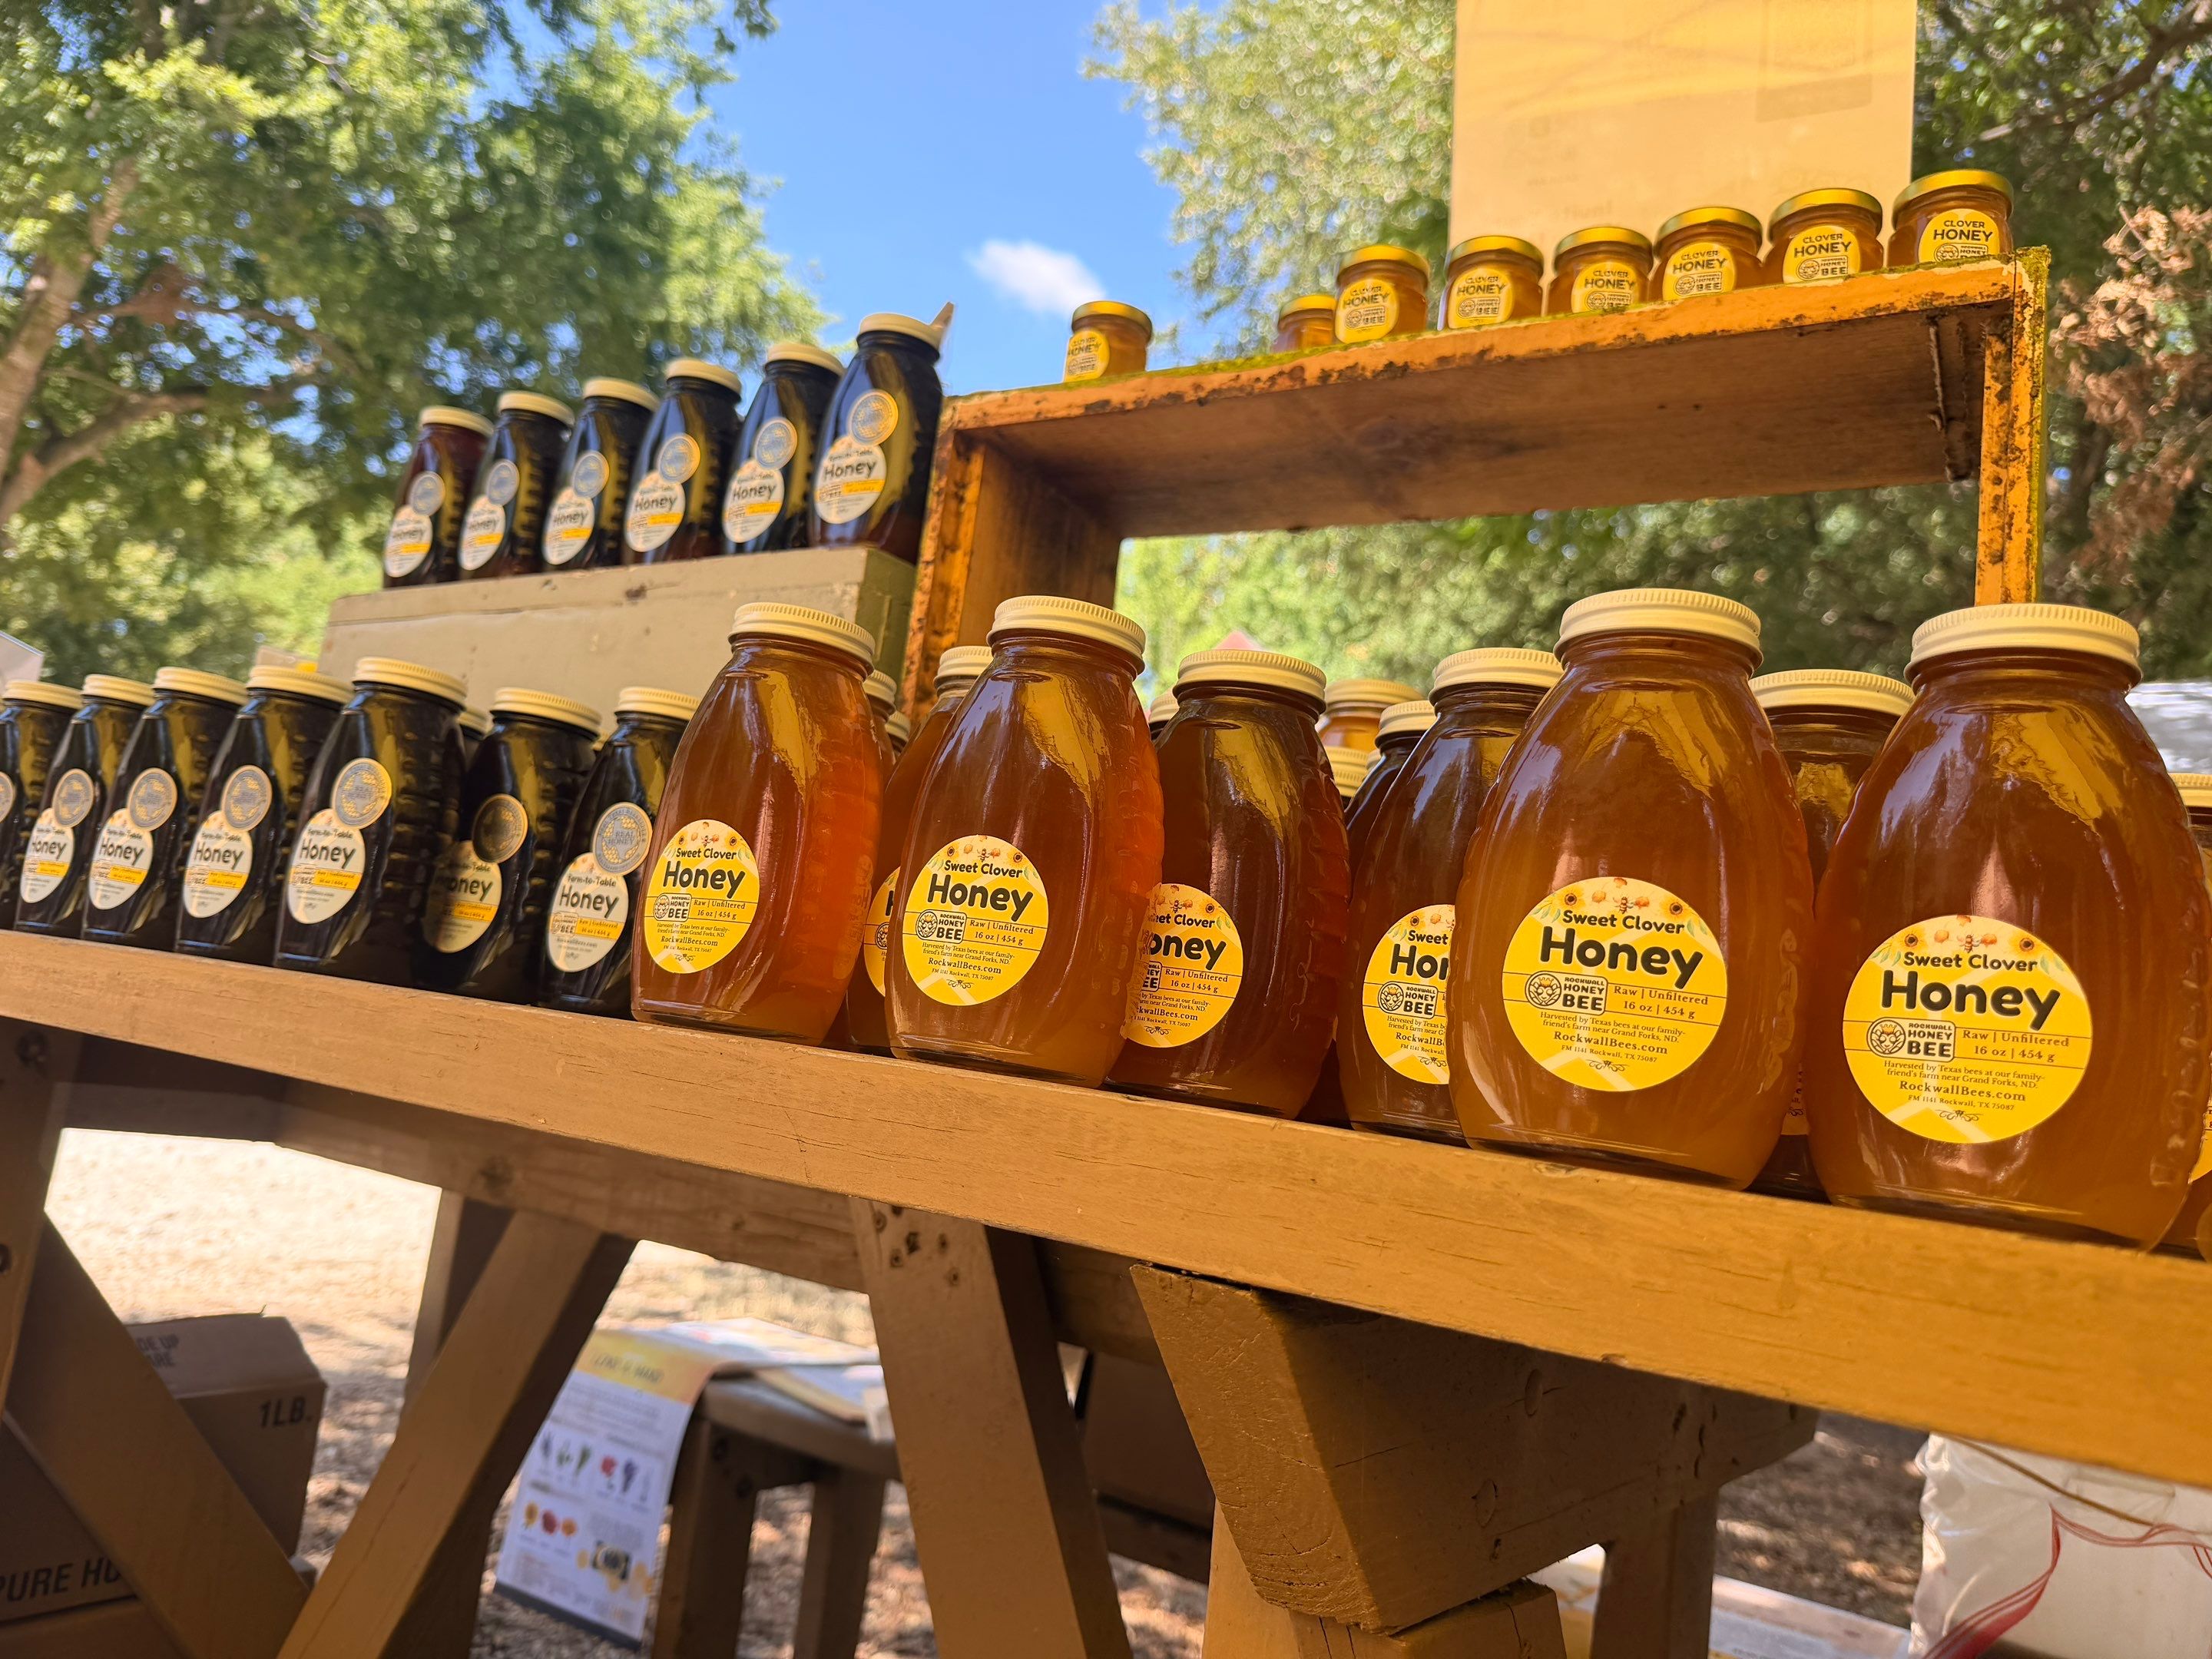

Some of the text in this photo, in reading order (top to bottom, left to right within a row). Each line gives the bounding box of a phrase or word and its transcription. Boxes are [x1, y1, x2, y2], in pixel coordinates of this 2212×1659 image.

[1803, 233, 1843, 243] CLOVER
[1934, 229, 1992, 242] HONEY
[1681, 251, 1718, 260] CLOVER
[1794, 242, 1851, 258] HONEY
[1673, 258, 1727, 273] HONEY
[1821, 267, 1846, 276] BEE
[1457, 284, 1505, 296] HONEY
[1584, 279, 1634, 290] HONEY
[1697, 283, 1721, 291] BEE
[1343, 293, 1390, 310] HONEY
[824, 461, 876, 479] Honey
[733, 485, 776, 500] Honey
[635, 496, 677, 512] Honey
[554, 513, 588, 528] Honey
[31, 837, 67, 859] Honey
[99, 838, 144, 866] Honey
[194, 842, 243, 870] Honey
[300, 839, 356, 869] Honey
[676, 848, 737, 859] Sweet Clover
[944, 859, 1023, 878] Sweet Clover
[663, 860, 746, 899] Honey
[446, 878, 493, 902] oney
[927, 873, 1033, 922] Honey
[559, 884, 619, 919] Honey
[712, 901, 746, 909] Unfiltered
[668, 909, 688, 919] BEE
[1174, 914, 1215, 928] Clover
[1562, 909, 1685, 934] Sweet Clover
[936, 927, 962, 940] BEE
[993, 922, 1034, 934] Unfiltered
[661, 936, 718, 946] RockwallBees.com
[1408, 930, 1448, 945] Sweet
[1151, 933, 1227, 970] oney
[1539, 926, 1704, 989] Honey
[929, 958, 1002, 974] RockwallBees.com
[1903, 951, 2038, 972] Sweet Clover
[1143, 977, 1158, 988] EE
[1188, 972, 1228, 982] Unfiltered
[1565, 977, 1604, 985] ROCKWALL
[1406, 992, 1435, 1002] HONEY
[1564, 984, 1604, 995] HONEY
[1614, 986, 1708, 1005] Raw Unfiltered
[1403, 1001, 1434, 1015] BEE
[1562, 994, 1604, 1011] BEE
[1881, 970, 2061, 1031] Honey
[1137, 1006, 1198, 1021] kwallBees.com
[1624, 1001, 1635, 1009] 16
[1664, 1006, 1684, 1015] 454
[1688, 1011, 1695, 1019] g
[1387, 1015, 1413, 1024] Harvested
[1541, 1012, 1577, 1022] Harvested
[1579, 1016, 1588, 1025] by
[1657, 1026, 1686, 1036] family-
[1543, 1020, 1571, 1028] friend's
[1611, 1028, 1635, 1037] Grand
[1638, 1031, 1661, 1041] Forks,
[1908, 1030, 1952, 1040] HONEY
[1963, 1030, 2069, 1047] Raw Unfiltered
[1396, 1032, 1444, 1046] RockwallB
[1554, 1031, 1668, 1055] RockwallBees.com
[1590, 1048, 1622, 1058] Rockwall,
[1907, 1041, 1952, 1057] BEE
[1975, 1046, 1988, 1055] 16
[2018, 1049, 2042, 1059] 454
[2048, 1054, 2055, 1063] g
[1885, 1061, 1924, 1070] Harvested
[1926, 1064, 1936, 1072] by
[1938, 1065, 1962, 1073] Texas
[2013, 1071, 2045, 1081] family-
[1887, 1068, 1916, 1077] friend's
[1962, 1075, 1989, 1084] Grand
[1992, 1078, 2018, 1088] Forks,
[1899, 1081, 2025, 1101] RockwallBees.com
[1939, 1098, 1975, 1108] Rockwall,
[259, 1397, 313, 1428] 1LB.
